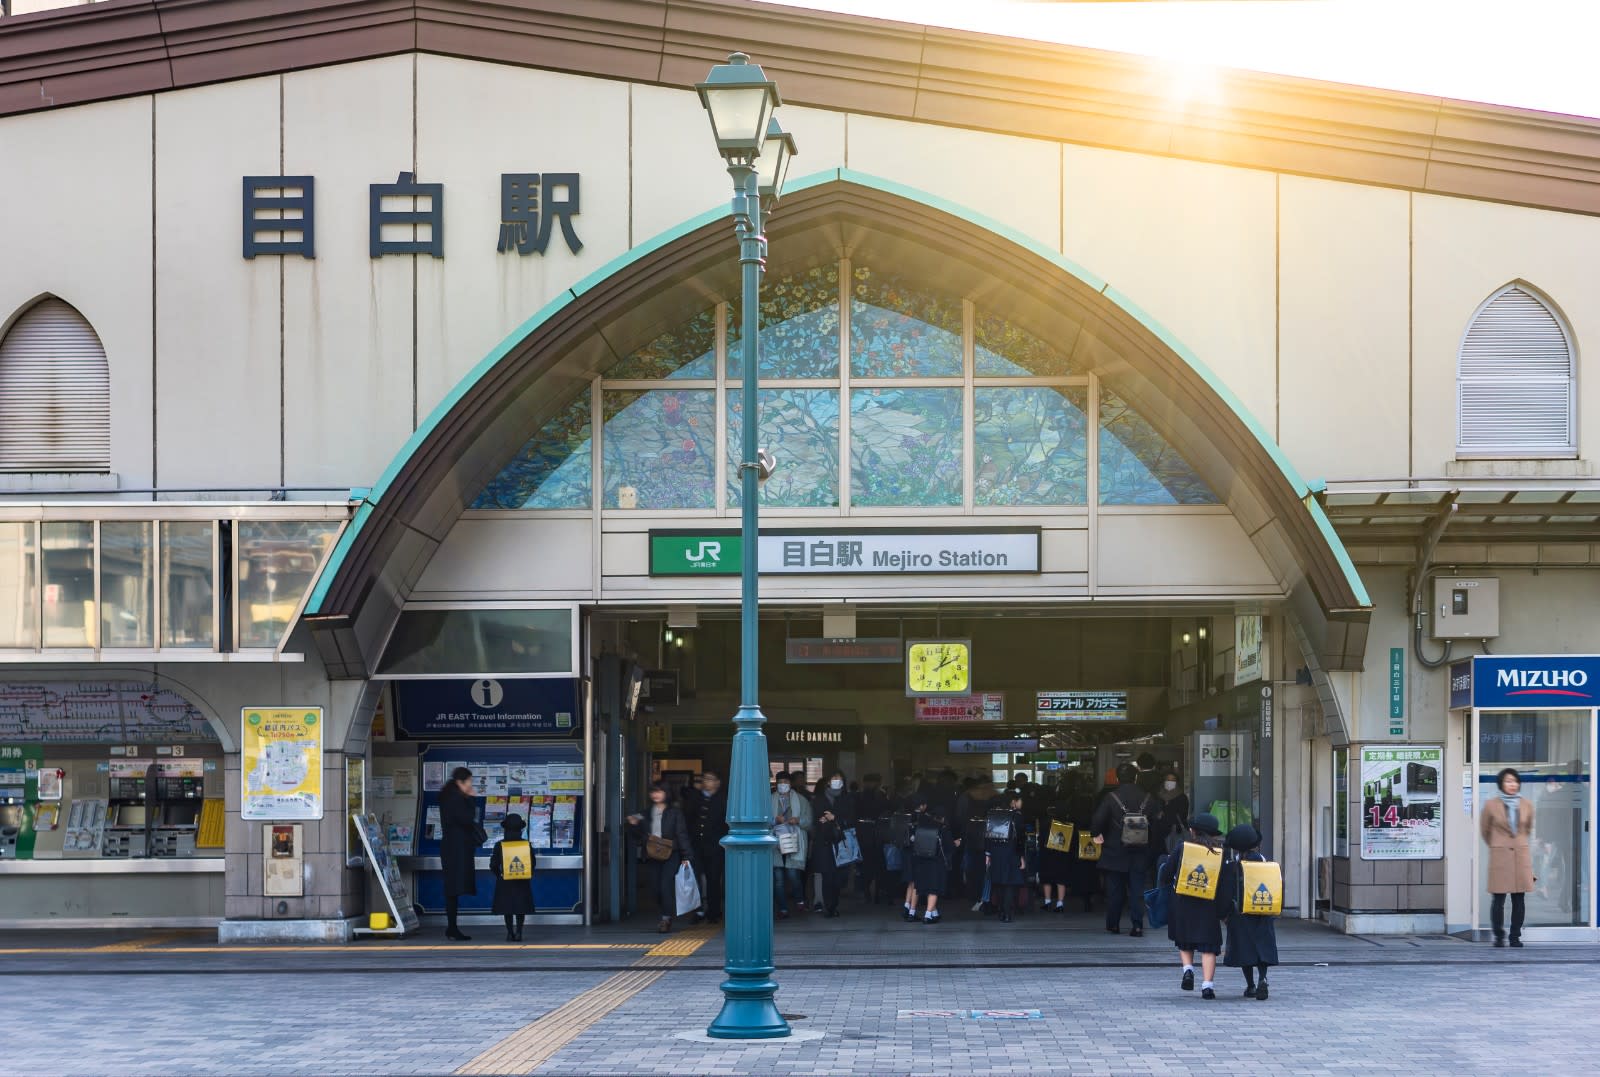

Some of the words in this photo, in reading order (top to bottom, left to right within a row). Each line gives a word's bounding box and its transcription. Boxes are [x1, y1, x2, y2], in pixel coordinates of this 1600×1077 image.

[243, 171, 583, 258] 目白駅
[686, 541, 721, 561] JR
[783, 541, 863, 567] 目白駅
[872, 550, 932, 570] Mejiro
[938, 550, 1008, 567] Station
[1496, 668, 1588, 687] MIZUHO
[1052, 698, 1083, 709] テアトル
[1086, 698, 1126, 709] アカデミー
[786, 729, 804, 741] CAFÉ
[807, 732, 842, 741] DANMARK
